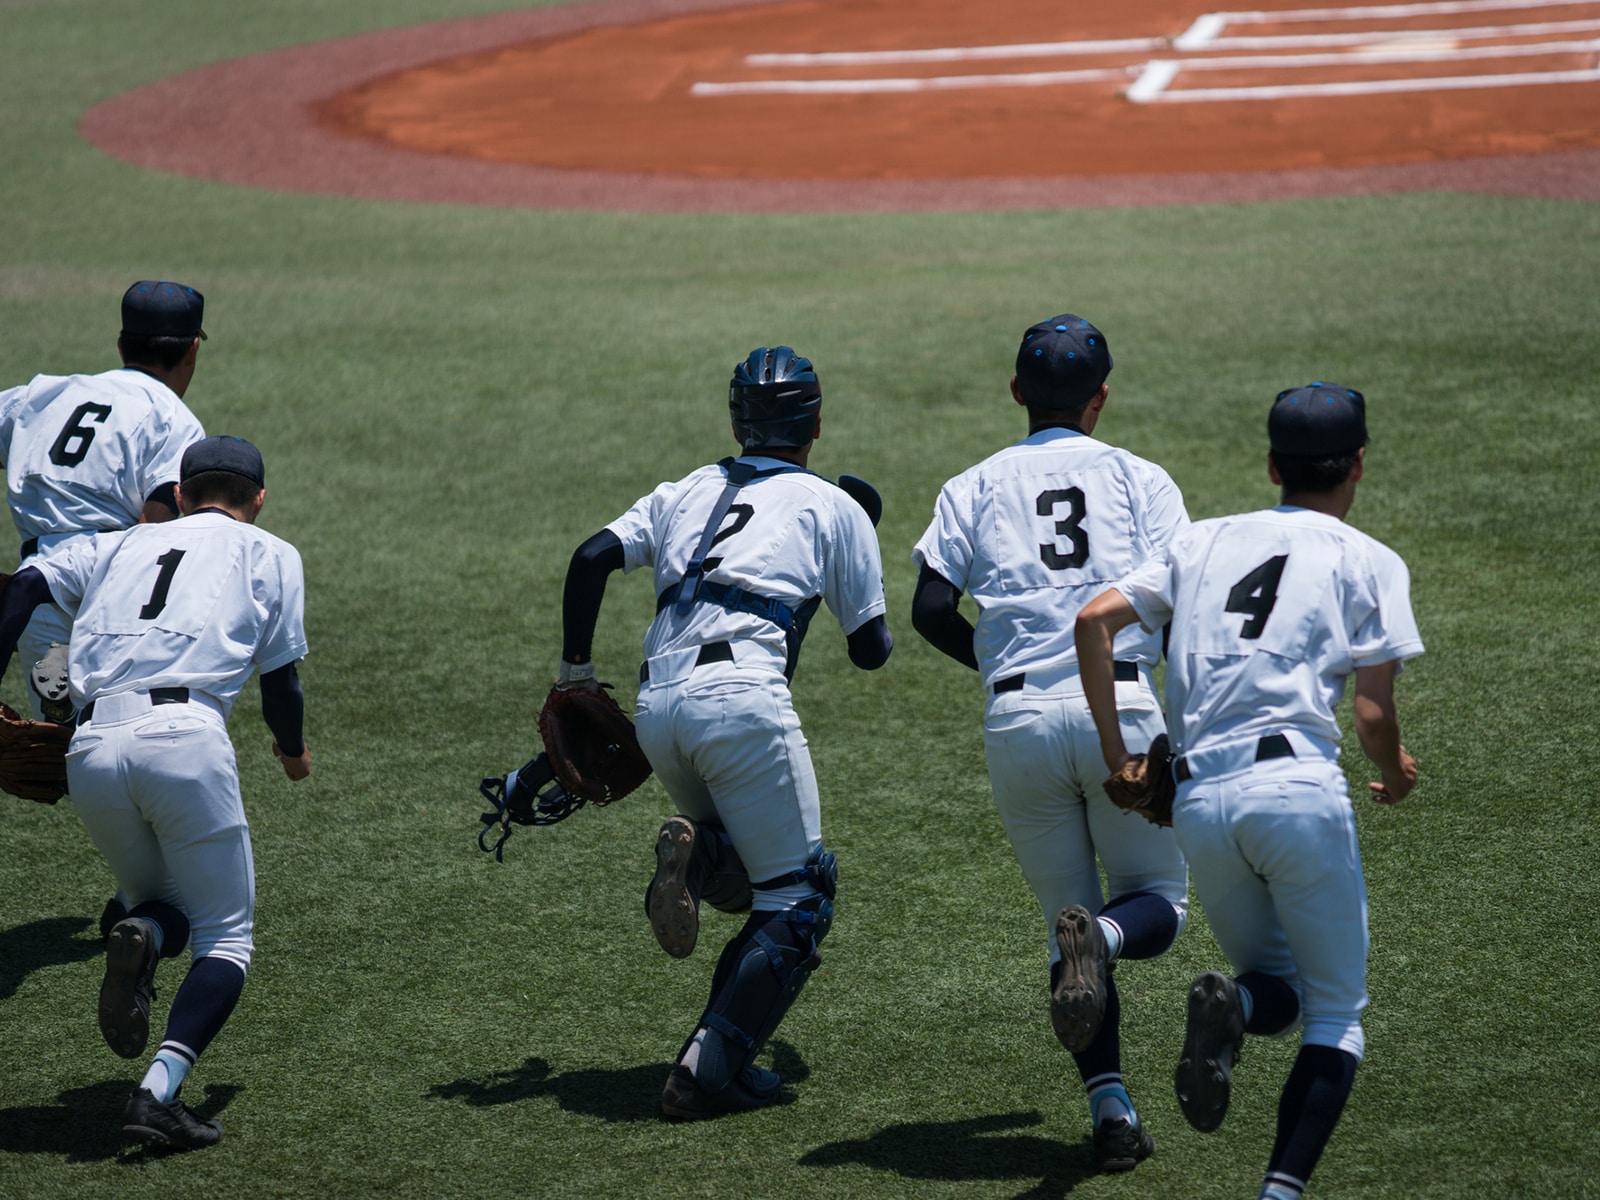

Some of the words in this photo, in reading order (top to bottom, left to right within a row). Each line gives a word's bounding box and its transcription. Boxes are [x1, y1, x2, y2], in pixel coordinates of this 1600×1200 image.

[49, 402, 112, 468] 6
[692, 503, 755, 572] 2
[1036, 486, 1090, 570] 3
[139, 549, 187, 620] 1
[1225, 554, 1289, 640] 4
